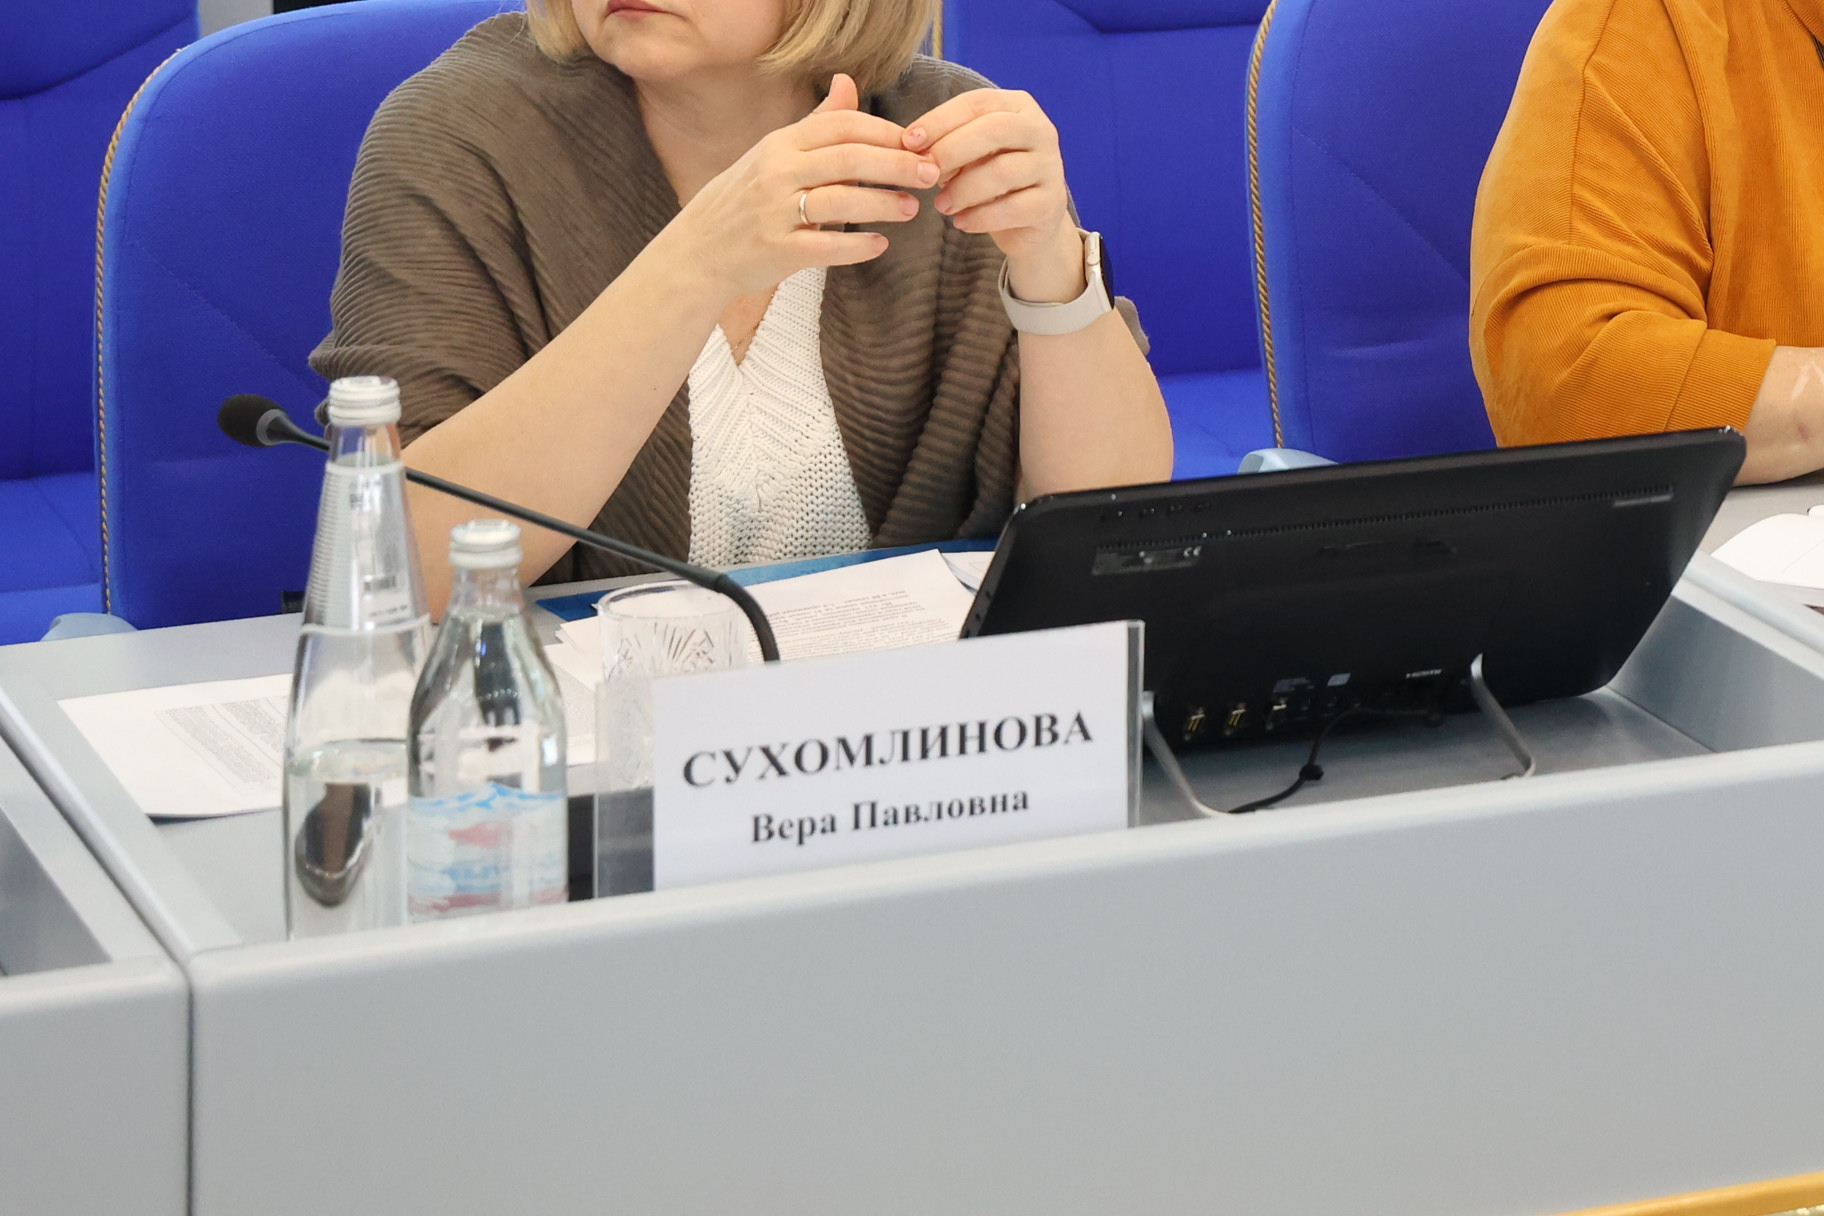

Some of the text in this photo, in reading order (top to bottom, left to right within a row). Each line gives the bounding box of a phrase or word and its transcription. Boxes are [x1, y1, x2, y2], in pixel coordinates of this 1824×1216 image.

[682, 710, 1094, 788] СУХОМЛИНОВА
[751, 790, 1031, 846] Вера Павловна
